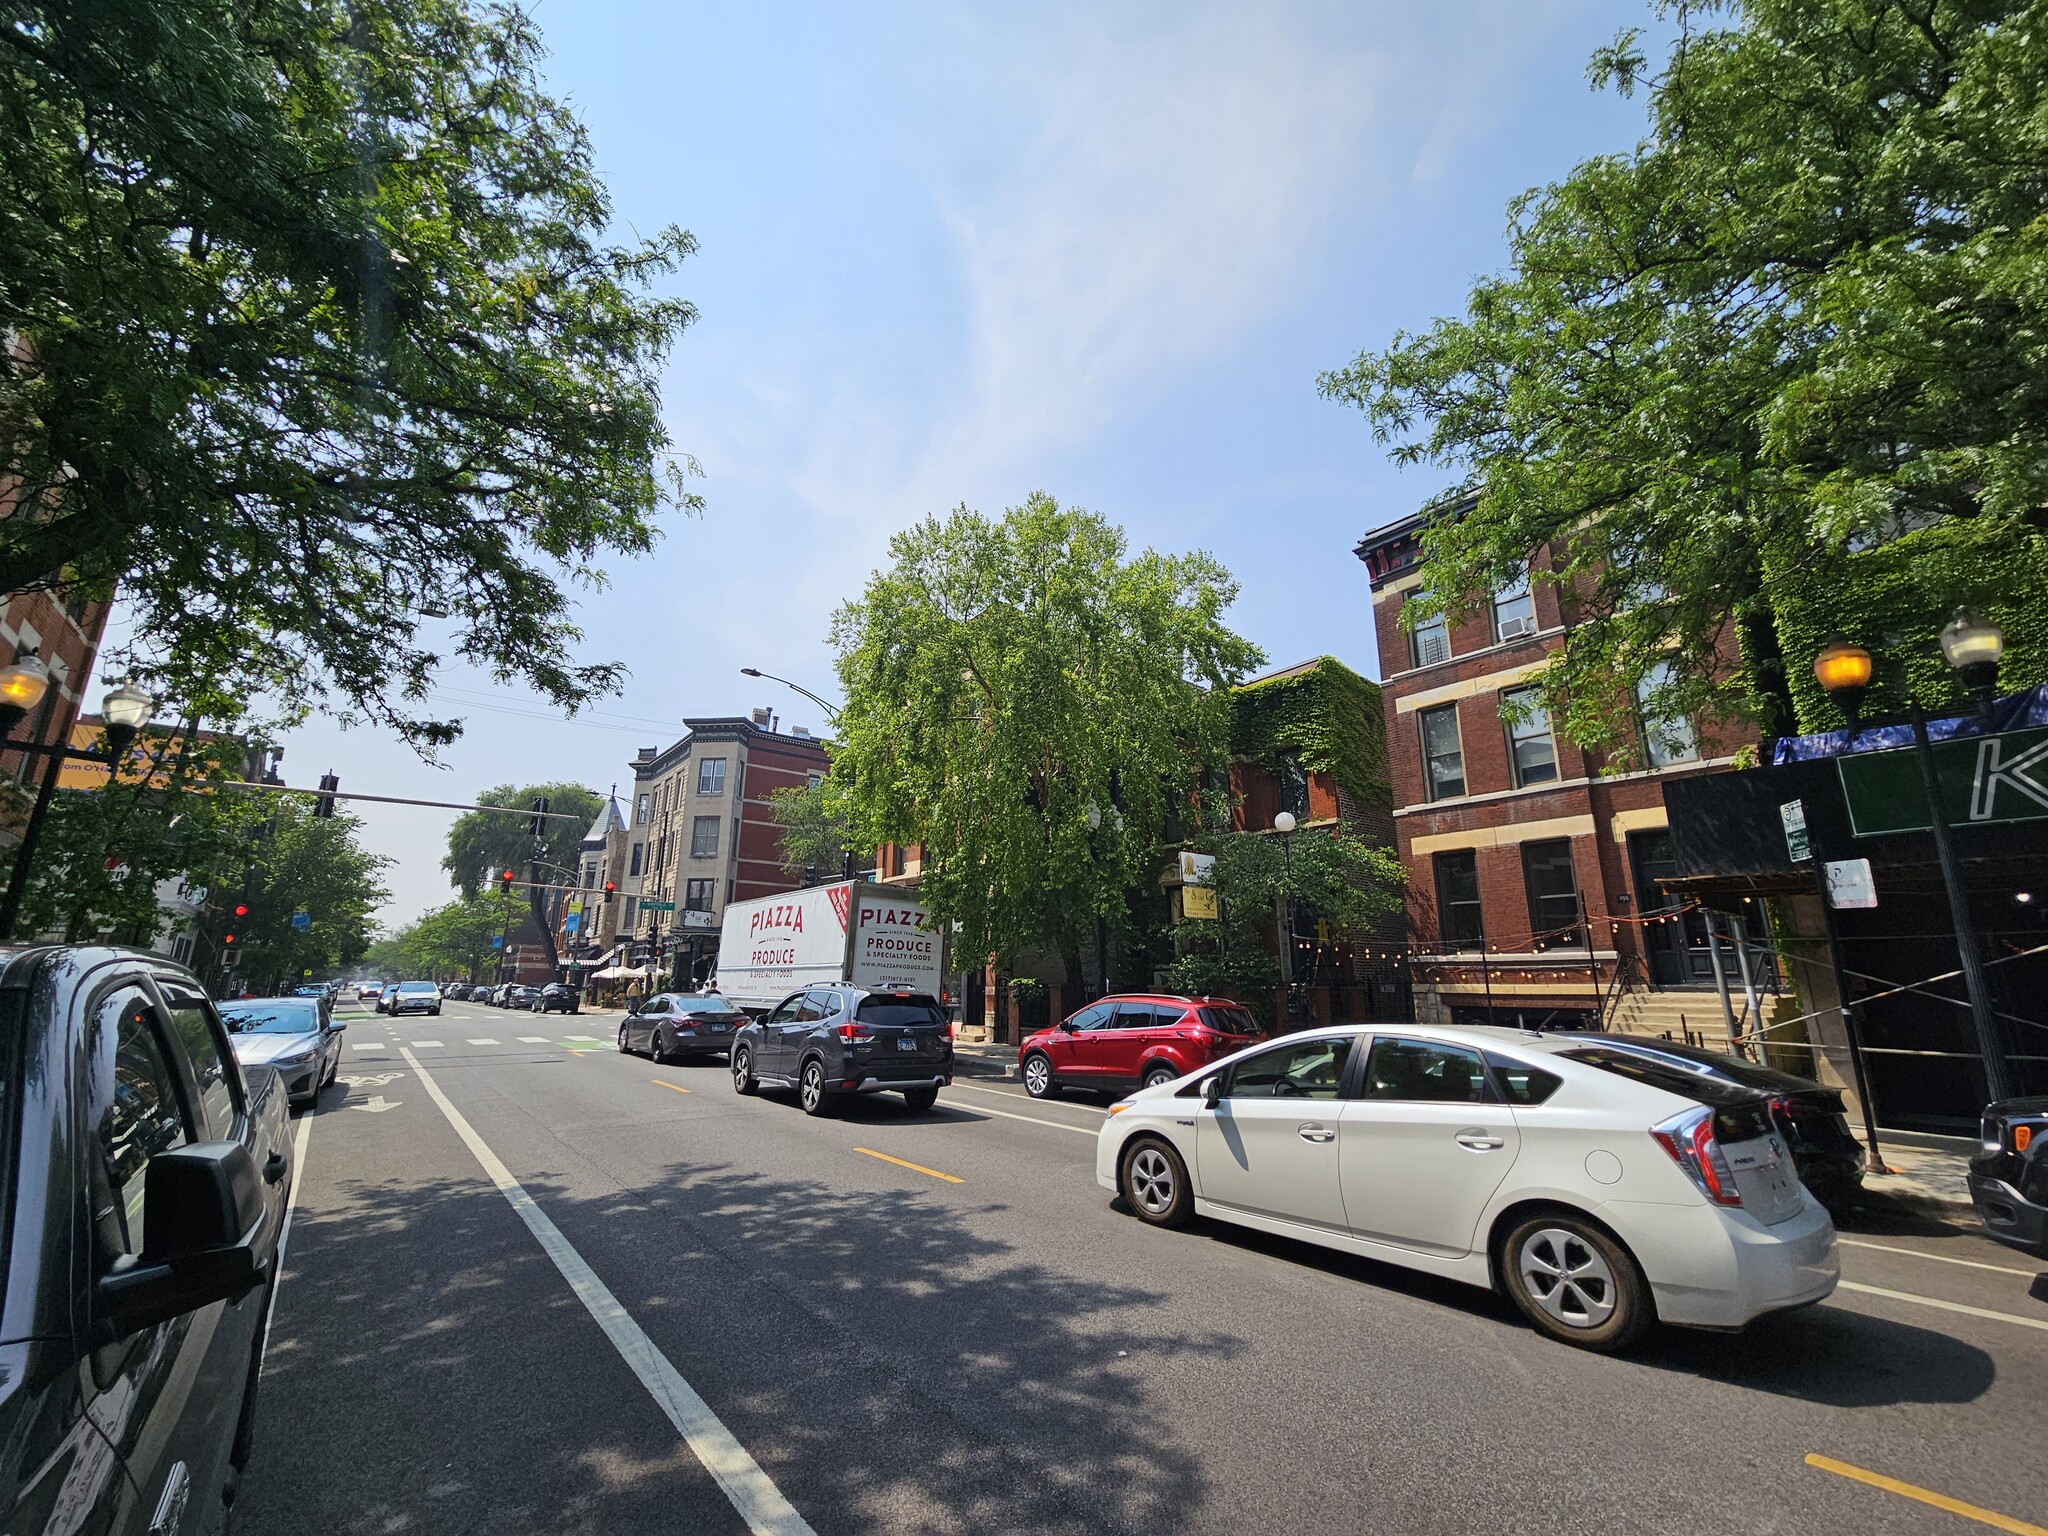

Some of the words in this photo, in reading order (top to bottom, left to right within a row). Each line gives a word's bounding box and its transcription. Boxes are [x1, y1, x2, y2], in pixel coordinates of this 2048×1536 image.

[1969, 738, 2048, 820] K
[750, 905, 803, 938] PIAZZA
[867, 937, 932, 953] PRODUCE
[751, 948, 795, 965] PRODUCE
[873, 951, 908, 960] SPECIALTY
[909, 954, 932, 962] FOODS
[754, 970, 776, 979] SPECIALTY
[776, 969, 793, 978] FOODS
[861, 962, 935, 971] WWW.PIAZZAPRODUCE.COM
